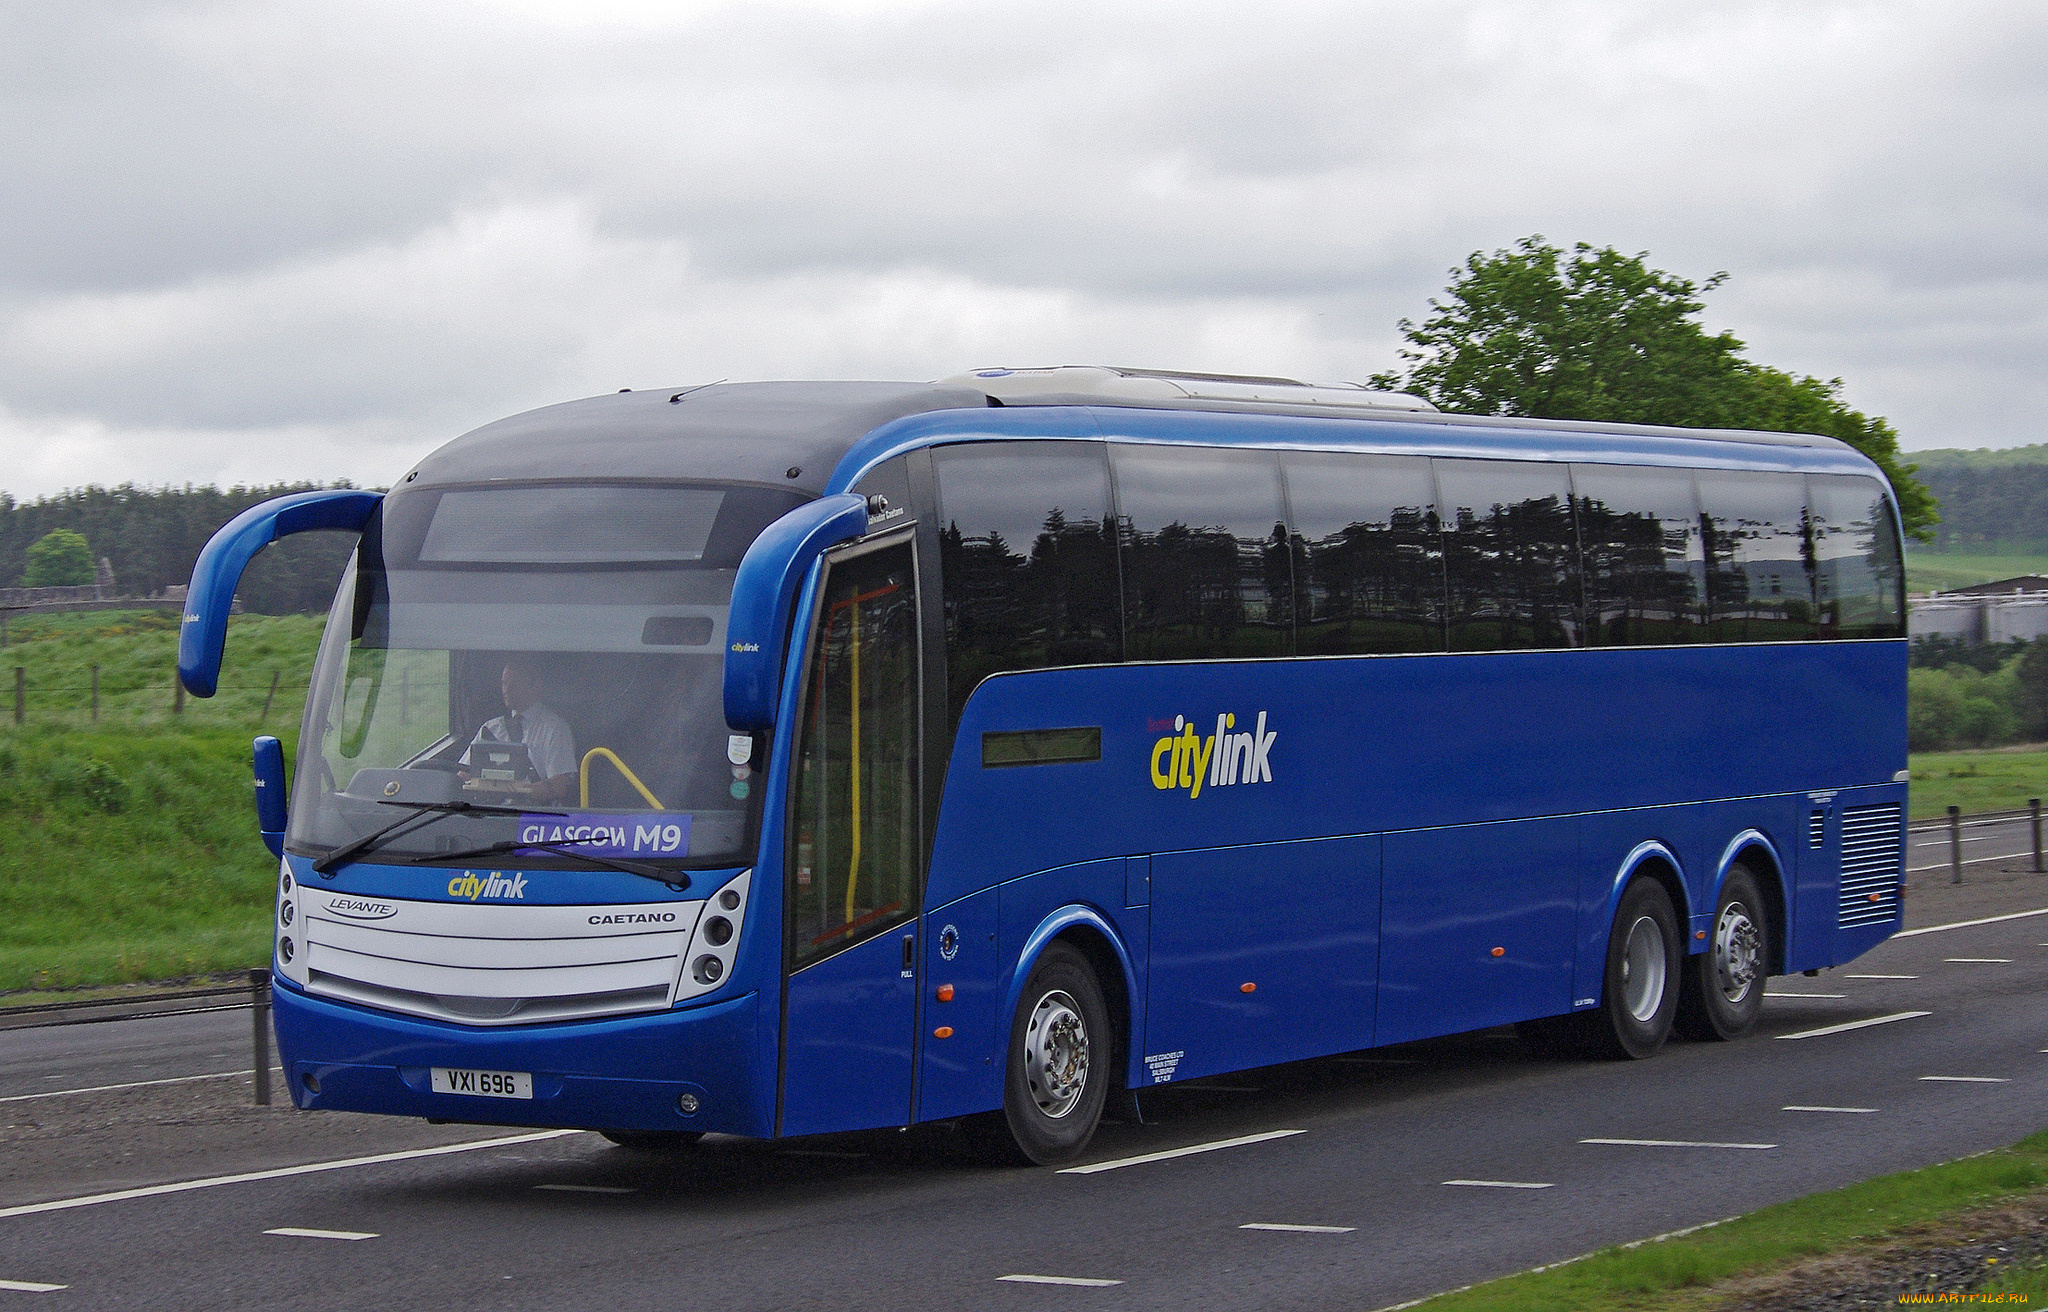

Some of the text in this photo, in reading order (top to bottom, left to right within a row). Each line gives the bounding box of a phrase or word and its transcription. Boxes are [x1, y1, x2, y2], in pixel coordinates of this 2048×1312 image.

[731, 642, 760, 652] citylink
[1151, 711, 1278, 799] citylink
[633, 825, 682, 852] M9
[448, 870, 528, 901] citylink
[329, 898, 392, 914] LEVANTE
[588, 912, 676, 925] CAETANO
[900, 970, 913, 978] PULL
[448, 1071, 515, 1094] VXI 696
